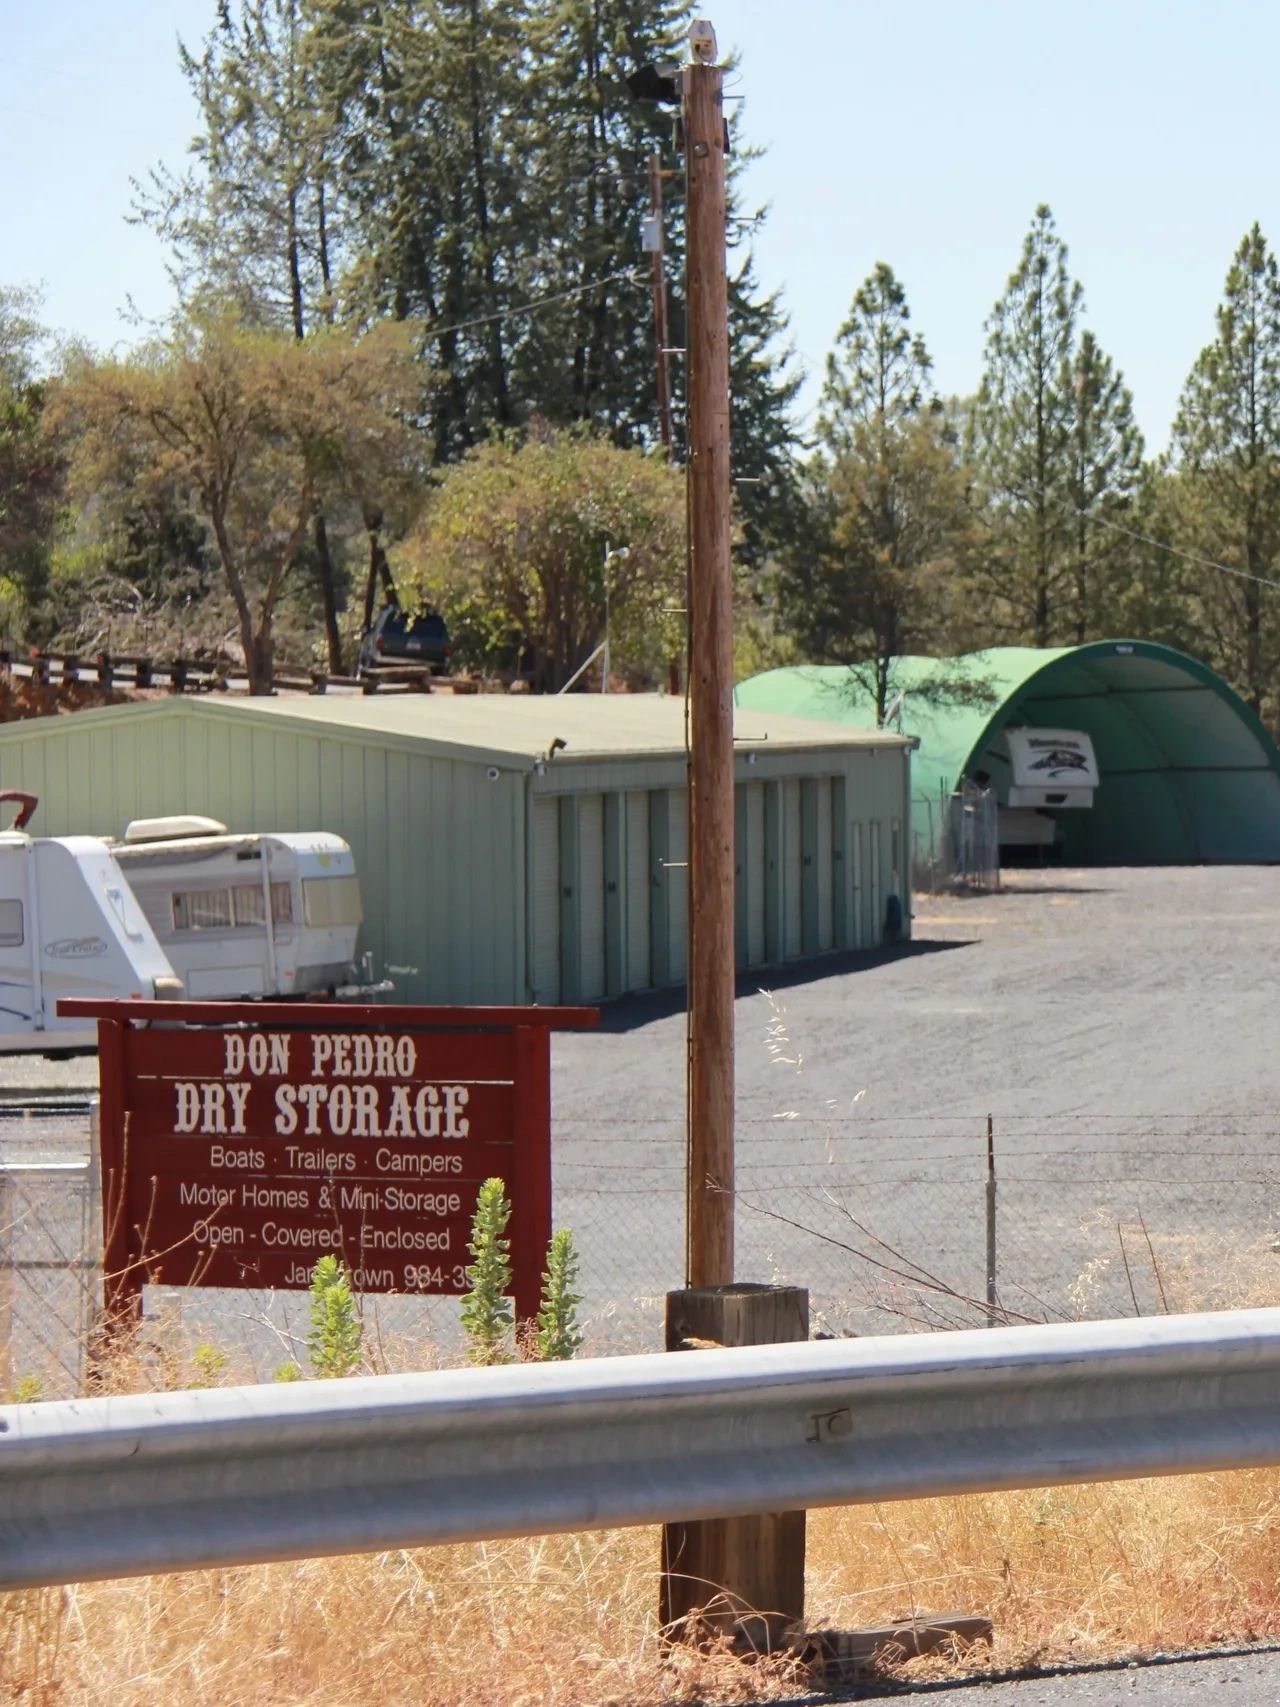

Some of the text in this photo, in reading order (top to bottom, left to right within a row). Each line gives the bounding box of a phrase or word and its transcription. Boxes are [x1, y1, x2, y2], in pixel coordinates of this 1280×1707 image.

[223, 1034, 417, 1077] DON PEDRO
[174, 1082, 470, 1138] DRY STORAGE
[210, 1146, 265, 1168] Boats
[285, 1146, 356, 1171] Trailers
[375, 1148, 463, 1176] Campers
[180, 1183, 236, 1206] Motor
[242, 1184, 309, 1208] Homes
[318, 1186, 332, 1209] &
[193, 1220, 244, 1247] Open
[261, 1221, 343, 1248] Covered
[362, 1225, 450, 1250] Enclosed
